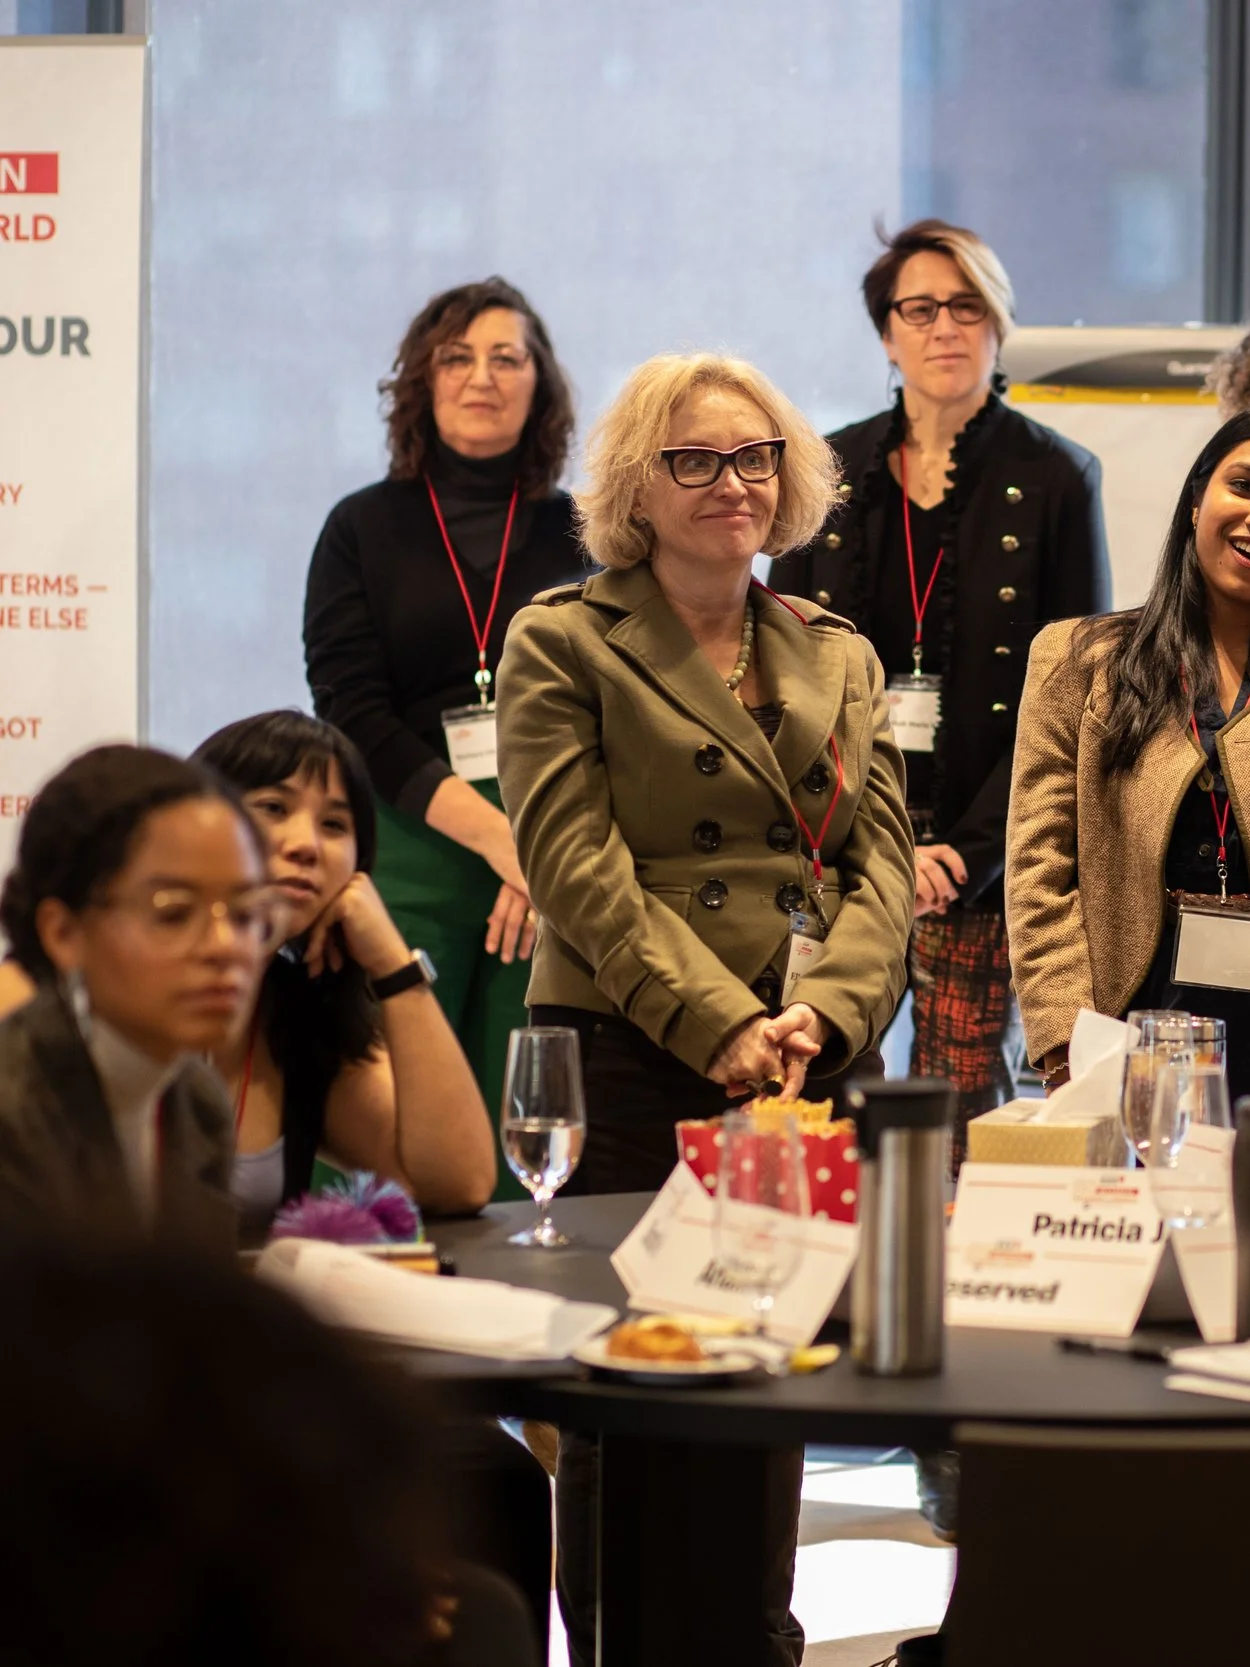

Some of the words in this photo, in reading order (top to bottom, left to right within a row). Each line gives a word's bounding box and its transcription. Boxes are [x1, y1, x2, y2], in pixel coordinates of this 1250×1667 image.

[0, 573, 79, 598] TERMS
[0, 605, 21, 630] E
[28, 606, 89, 632] ELSE
[1033, 1212, 1144, 1244] Patricia
